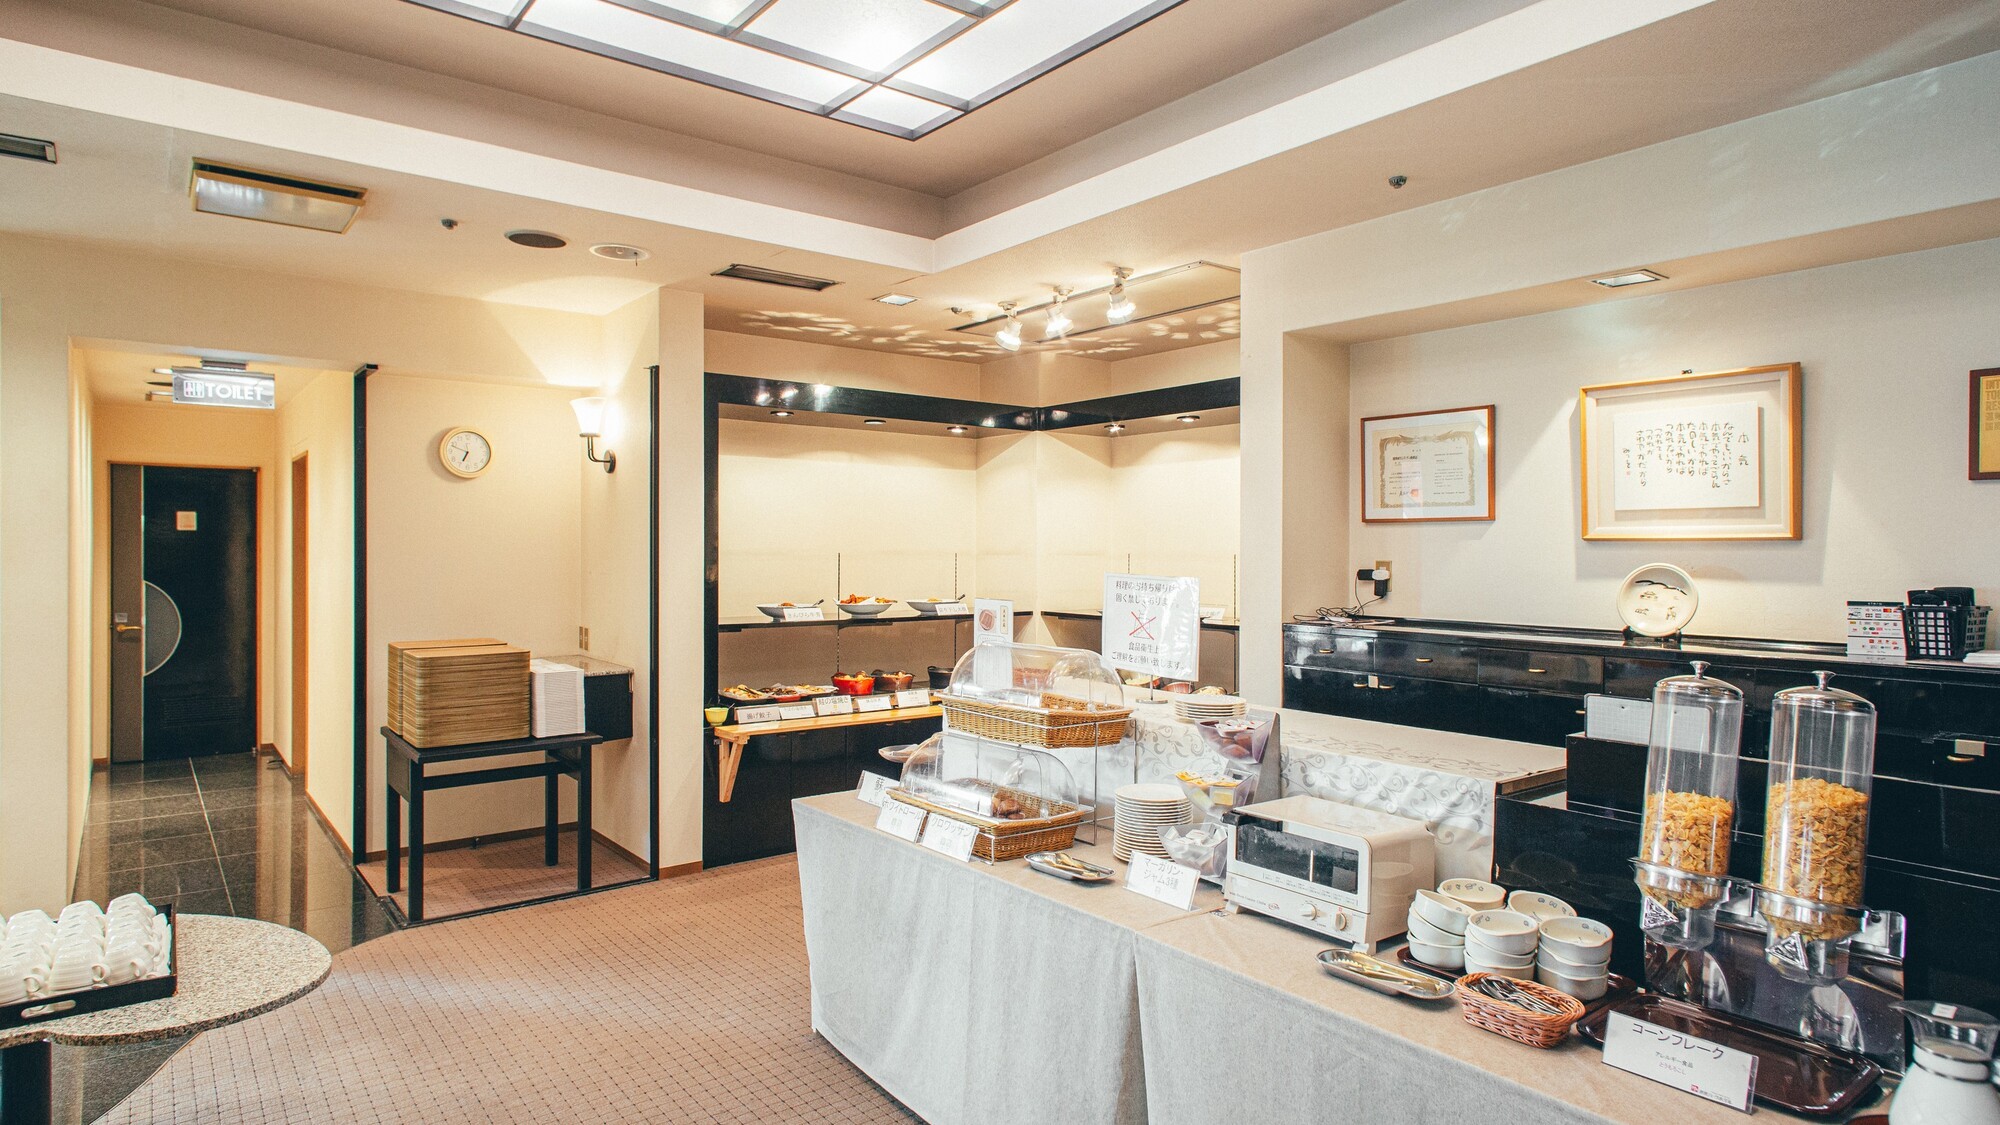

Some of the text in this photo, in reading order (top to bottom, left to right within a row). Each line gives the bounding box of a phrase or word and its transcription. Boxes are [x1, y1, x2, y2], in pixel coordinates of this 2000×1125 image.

[204, 382, 263, 401] TOILET
[1128, 641, 1160, 655] 食品衛生上
[931, 816, 973, 838] クロワッサン
[1632, 1023, 1725, 1060] コーンフレーク
[1655, 1051, 1695, 1069] アレルギー食品
[1658, 1061, 1687, 1076] とうもろこし
